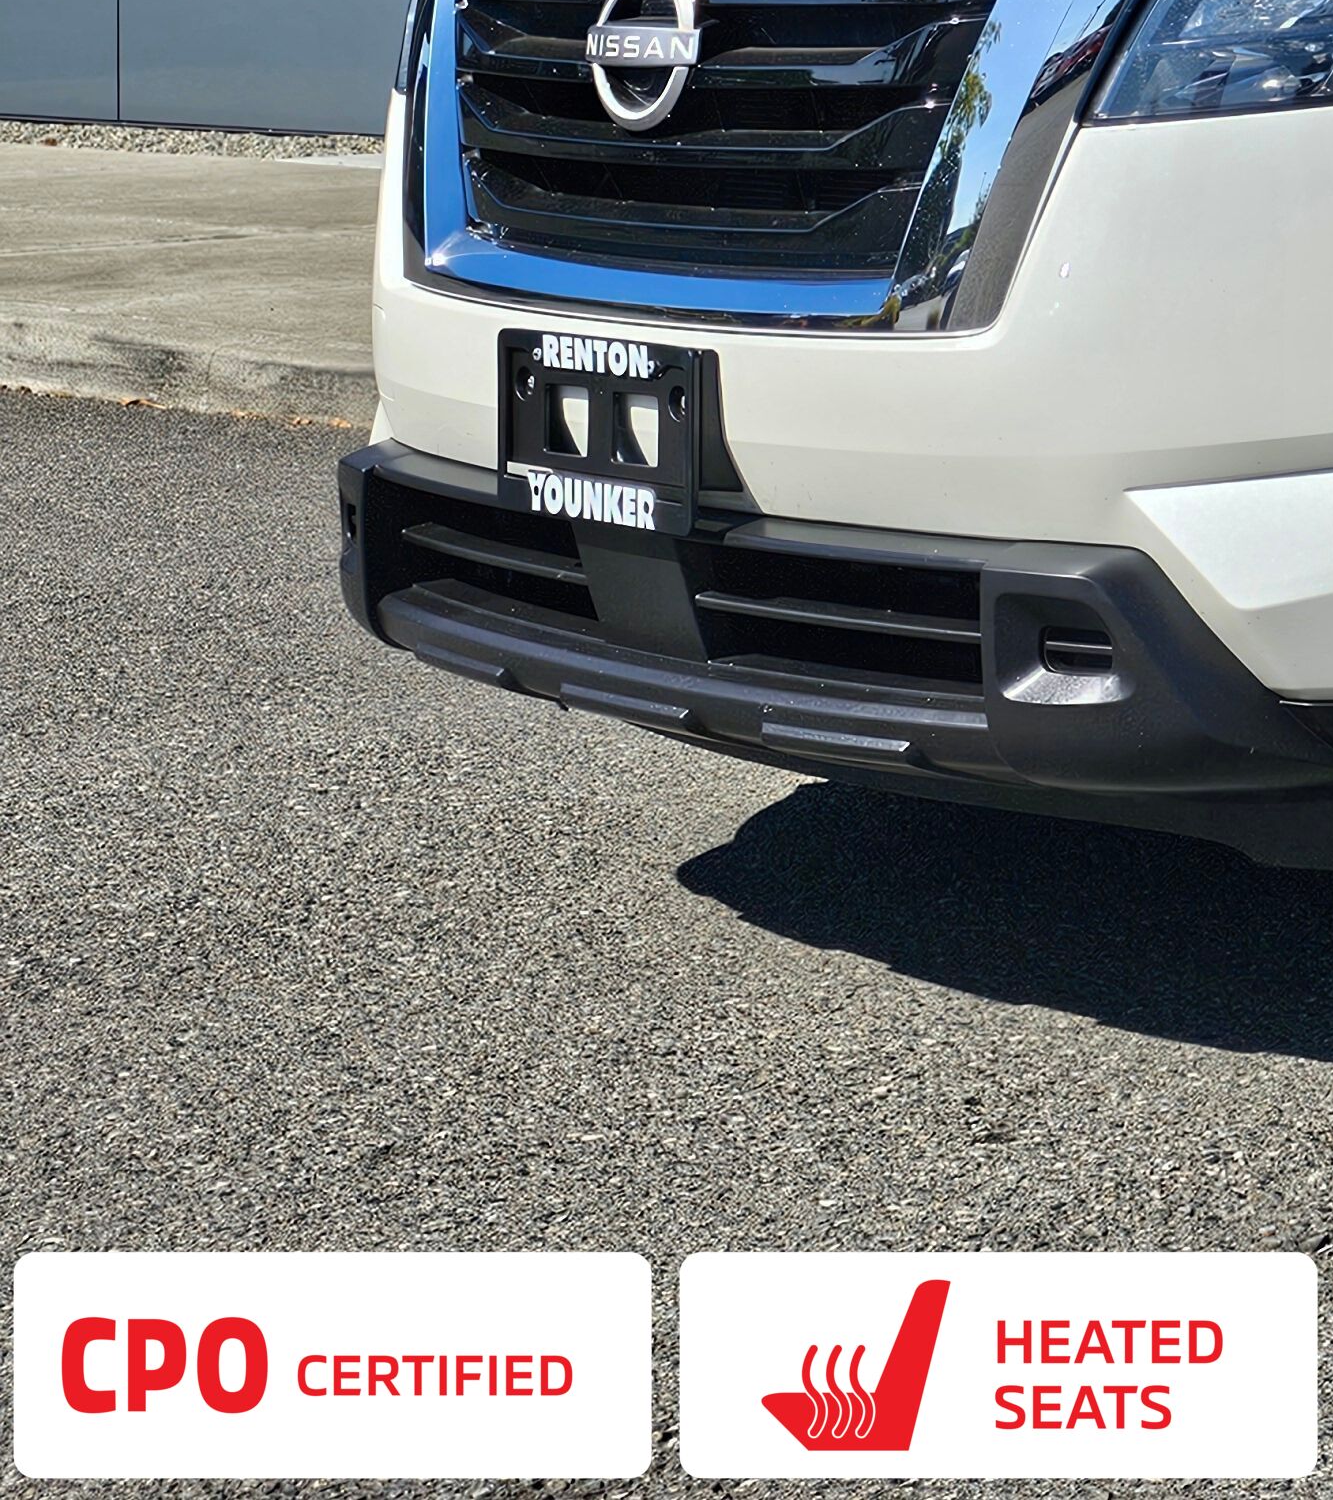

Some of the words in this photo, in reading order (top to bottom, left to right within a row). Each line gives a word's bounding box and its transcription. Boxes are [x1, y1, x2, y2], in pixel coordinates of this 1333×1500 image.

[586, 33, 694, 60] NISSAN
[542, 334, 649, 378] RENTON
[527, 472, 656, 530] YOUNKER
